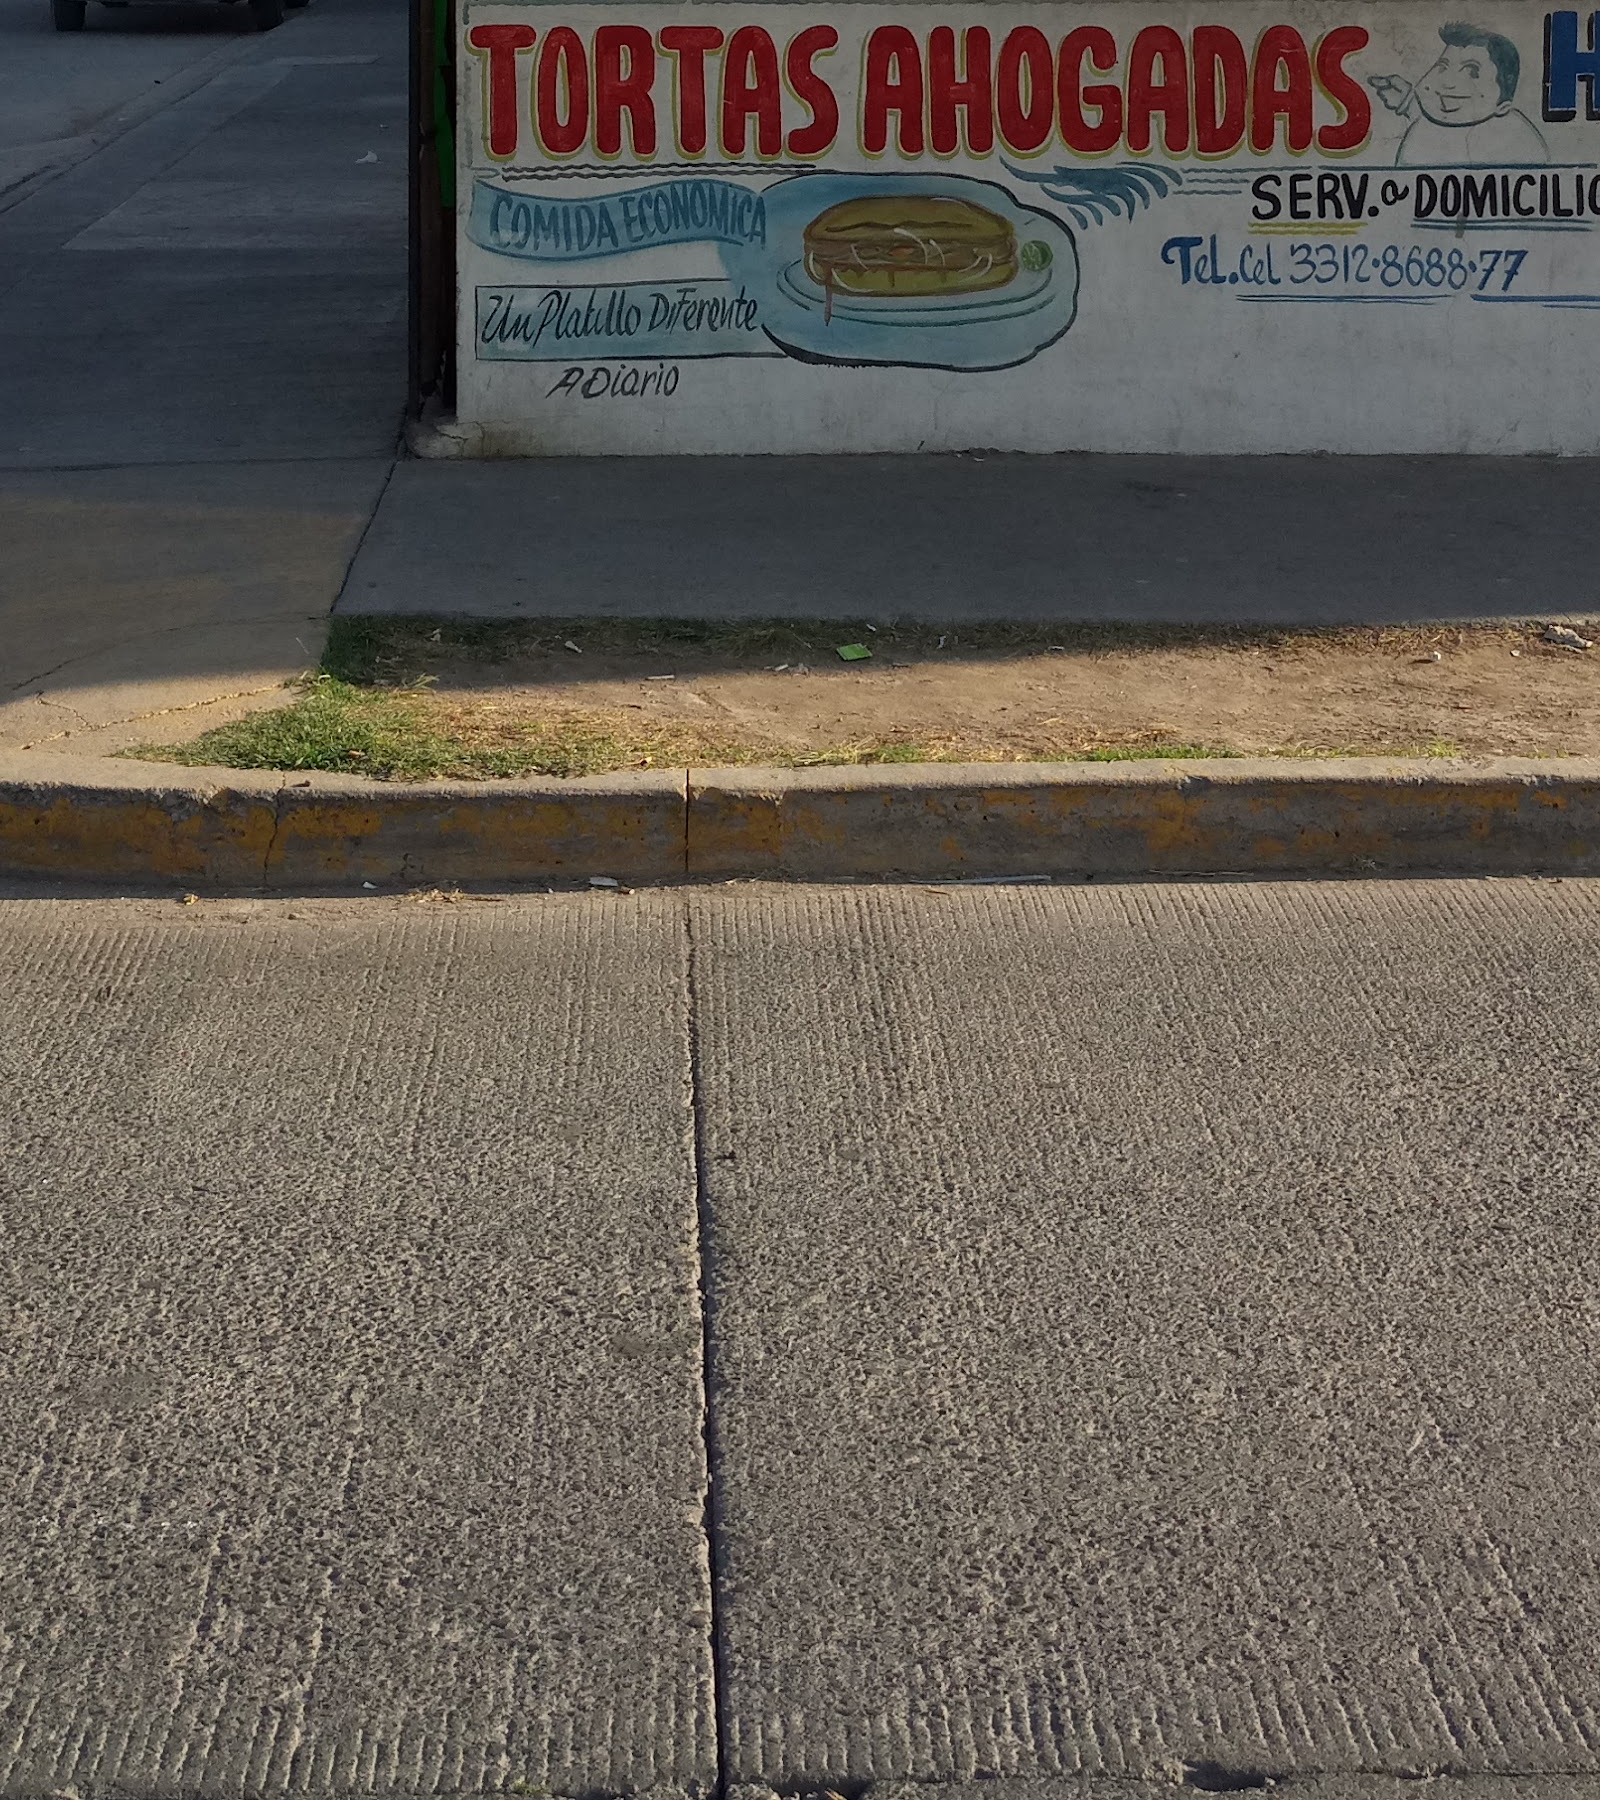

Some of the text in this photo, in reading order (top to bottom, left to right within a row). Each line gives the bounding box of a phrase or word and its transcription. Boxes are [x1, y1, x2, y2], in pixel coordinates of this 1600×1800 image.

[467, 24, 1371, 161] TORTAS AHOGADAS
[489, 193, 620, 250] COMIDA
[1250, 172, 1380, 221] SERV.
